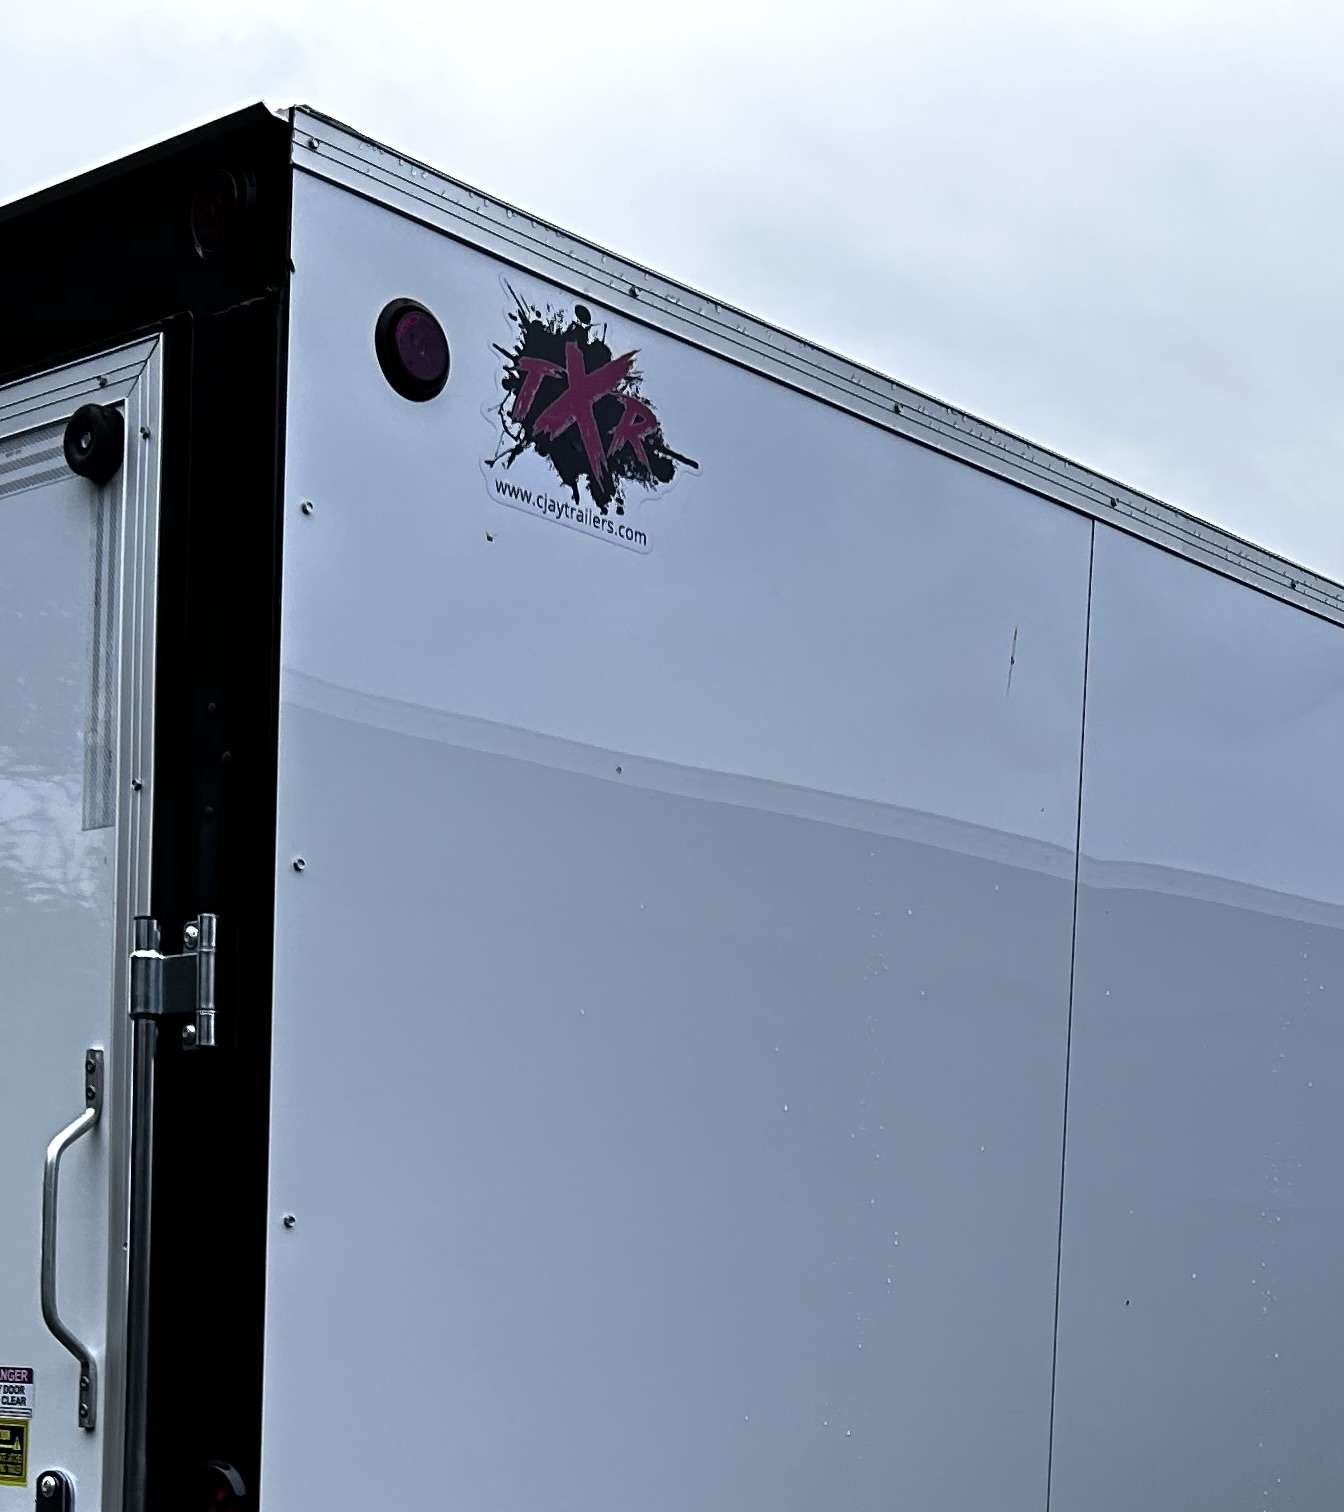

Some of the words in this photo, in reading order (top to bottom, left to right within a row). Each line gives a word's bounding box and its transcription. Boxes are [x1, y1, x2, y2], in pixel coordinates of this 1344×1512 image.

[495, 478, 648, 546] www.cjaytrailers.com
[3, 1385, 26, 1395] DOOR
[1, 1396, 27, 1406] CLEAR
